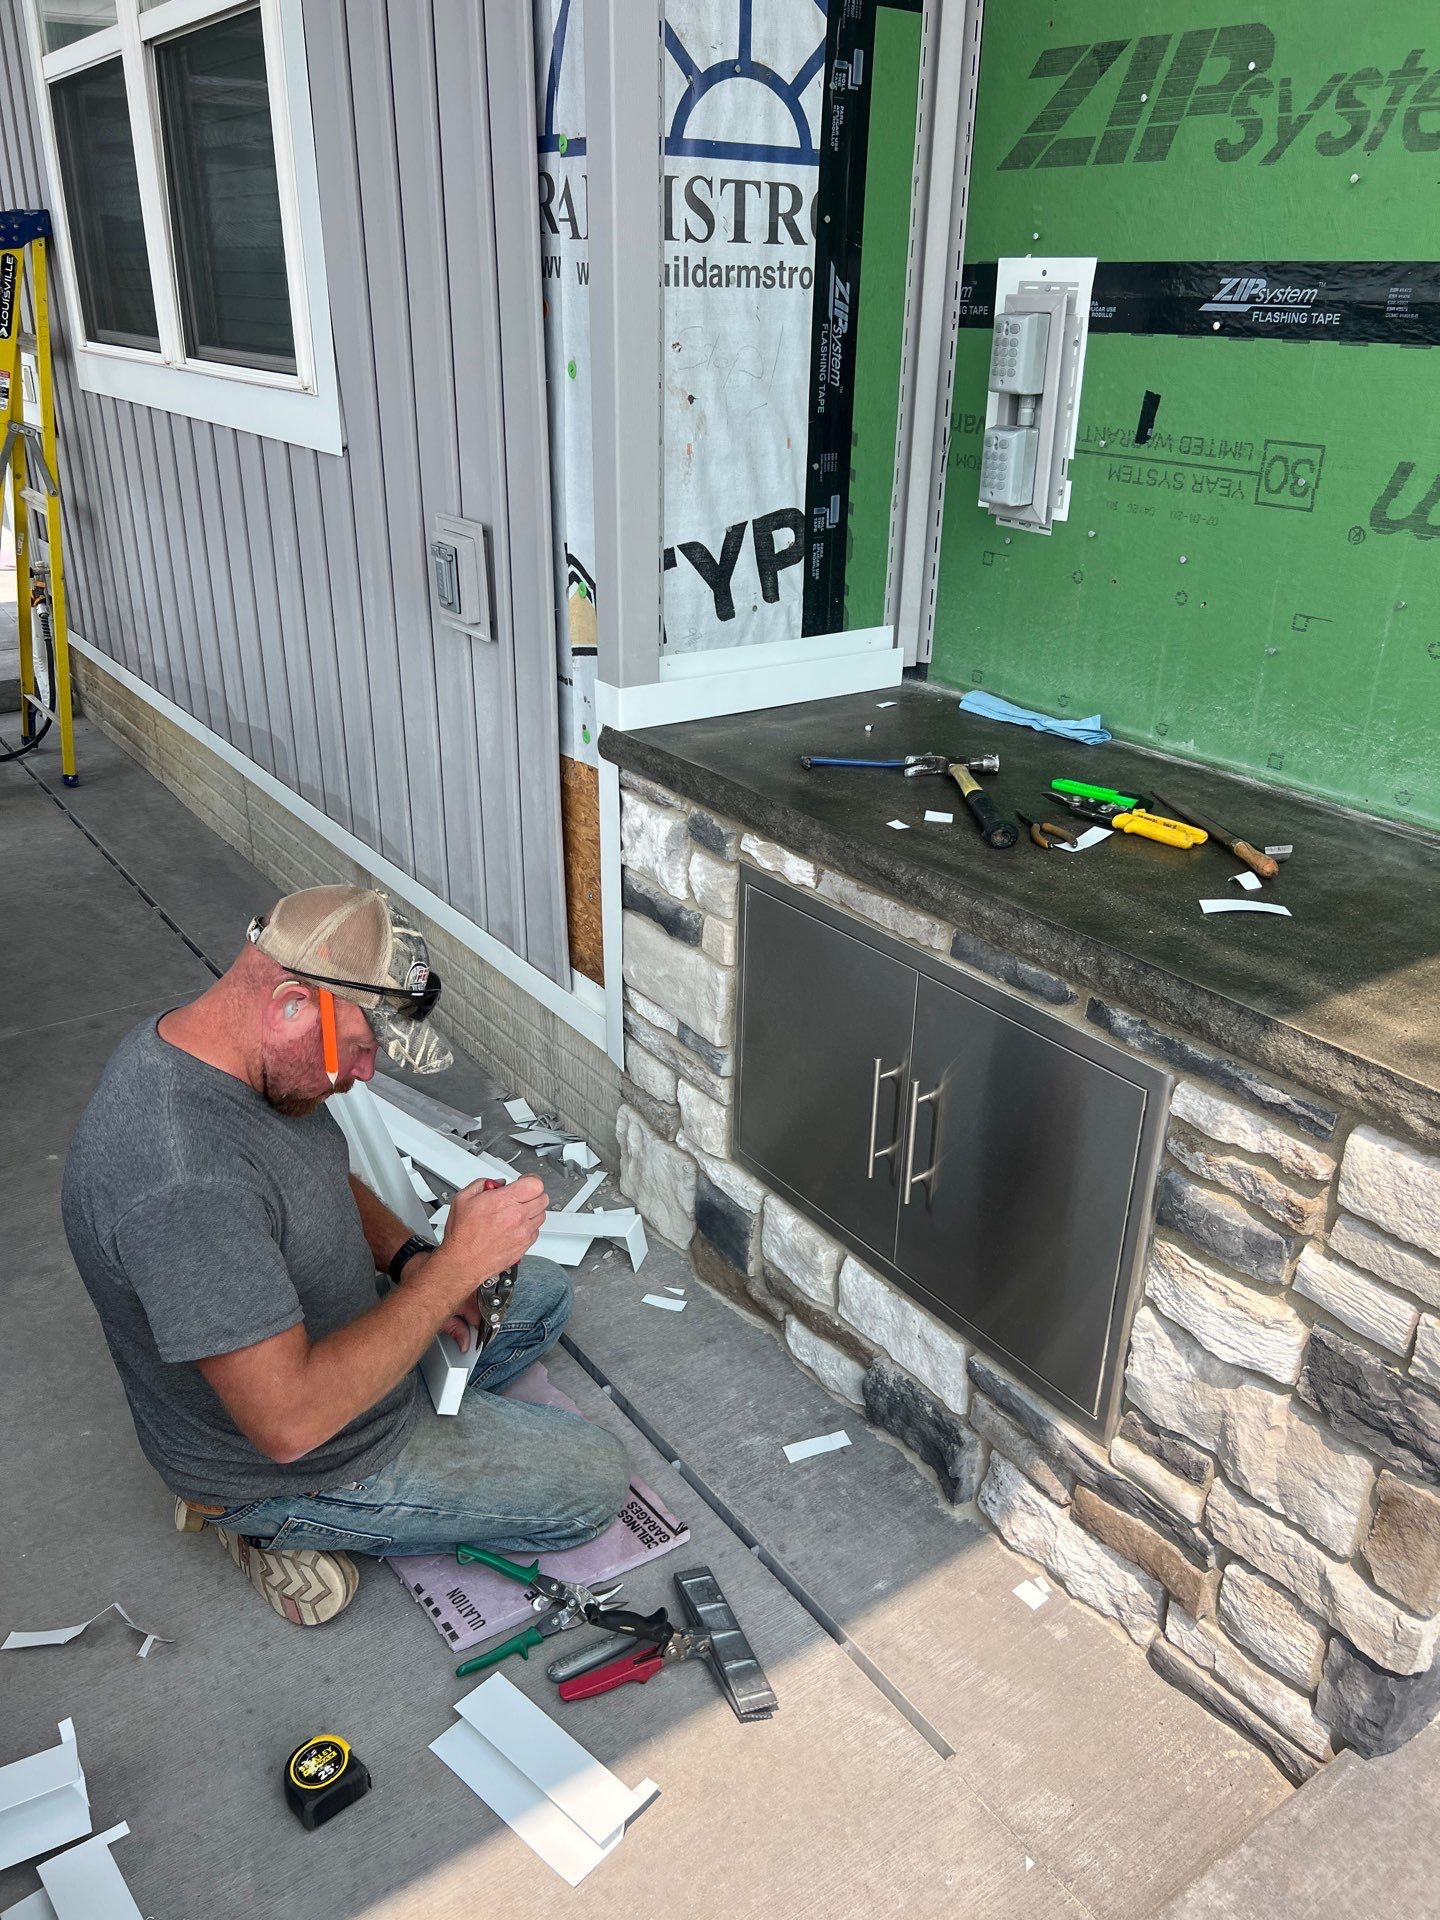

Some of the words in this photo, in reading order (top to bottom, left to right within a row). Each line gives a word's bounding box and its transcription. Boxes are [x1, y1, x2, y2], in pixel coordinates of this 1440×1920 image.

[1, 255, 15, 328] LOUISVILLE
[969, 305, 989, 316] TAPE
[1251, 310, 1309, 325] FLASHING
[1311, 312, 1341, 326] TAPE
[818, 323, 830, 381] FLASHING
[816, 384, 826, 414] TAPE
[1178, 435, 1254, 461] LIMITED
[1107, 463, 1186, 490] SYSTEM
[1191, 473, 1246, 500] YEAR
[1264, 455, 1315, 498] 30
[617, 1509, 659, 1550] CEILINGS
[626, 1501, 671, 1543] GARAGES
[446, 1587, 486, 1631] ULATION
